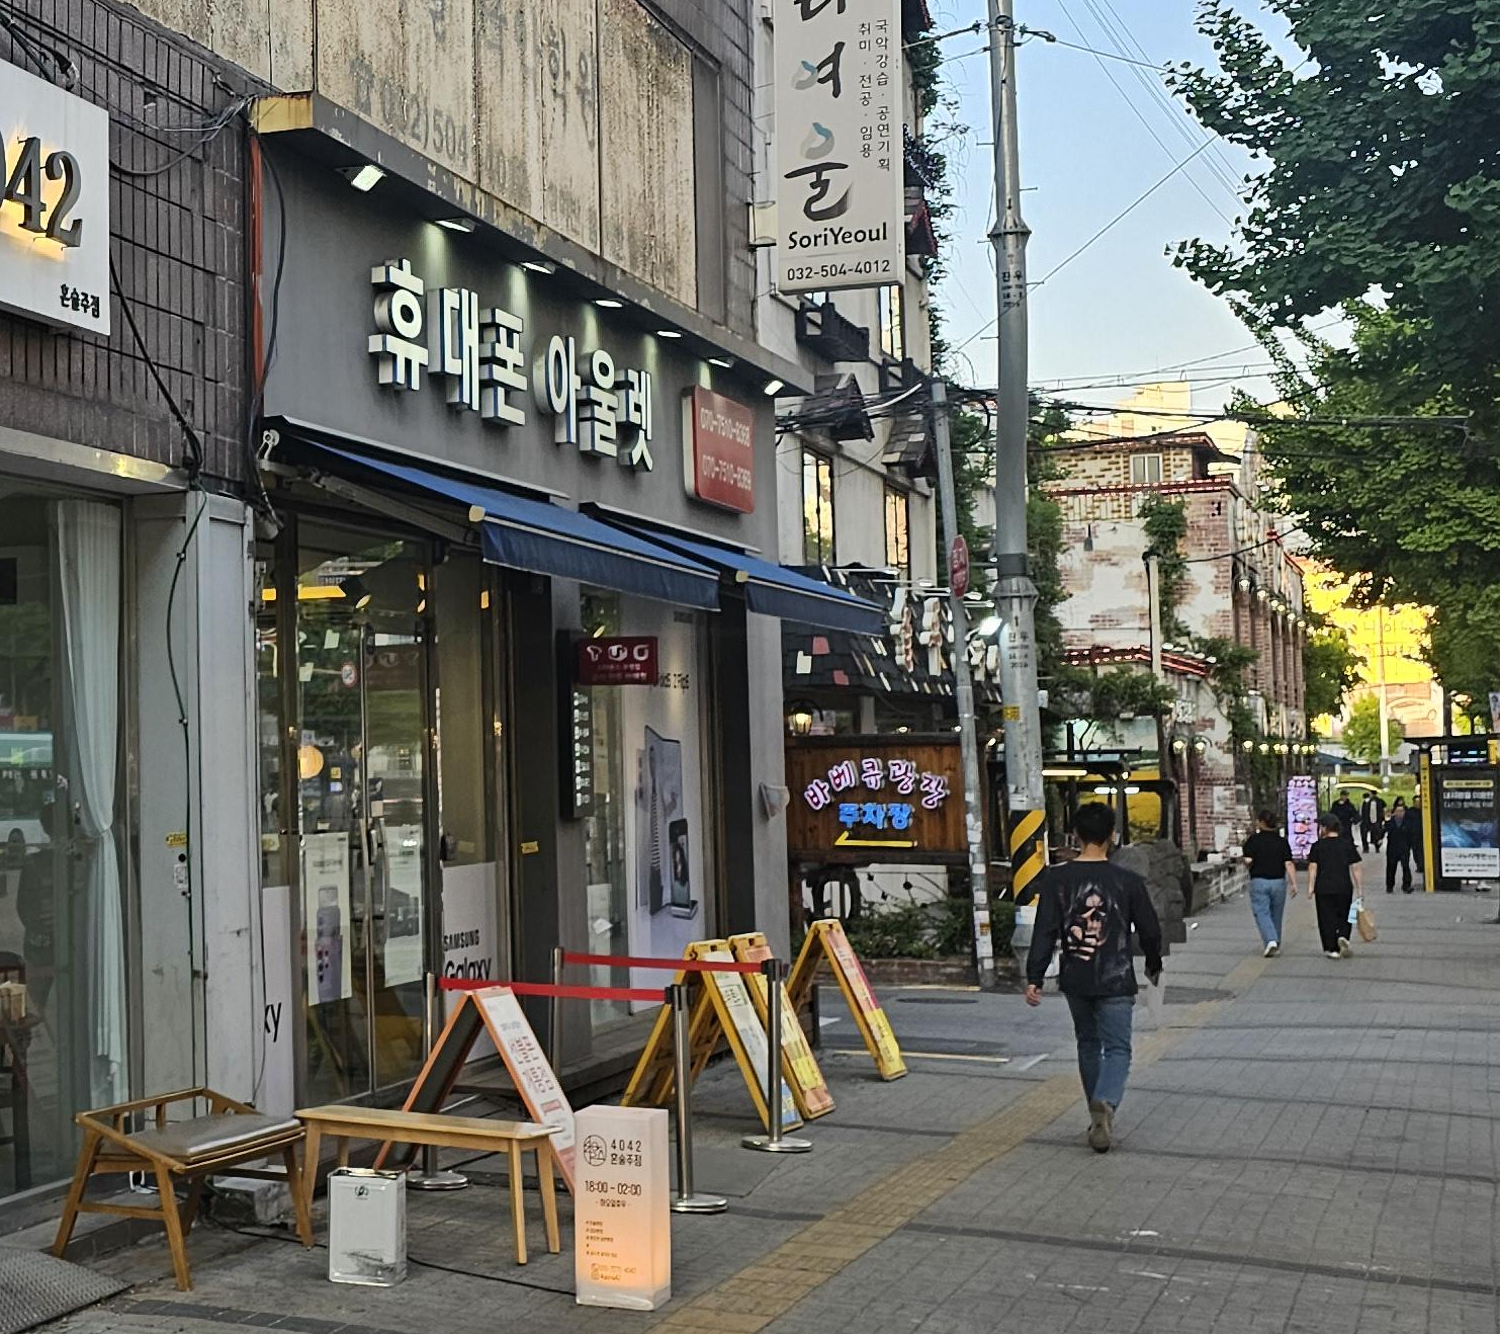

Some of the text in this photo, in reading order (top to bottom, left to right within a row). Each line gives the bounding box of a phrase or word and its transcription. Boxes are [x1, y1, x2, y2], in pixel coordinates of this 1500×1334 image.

[788, 222, 888, 250] SoriYeoul
[787, 259, 890, 281] 032-504-4012
[59, 283, 101, 319] 혼술주점
[370, 258, 654, 472] 휴대폰 아울렛
[804, 758, 949, 810] 바베큐광장
[838, 802, 914, 829] 주차장
[444, 929, 479, 953] SAMSUNG
[445, 957, 492, 980] Galaxy
[611, 1139, 641, 1152] 4042
[585, 1180, 608, 1193] 18:00
